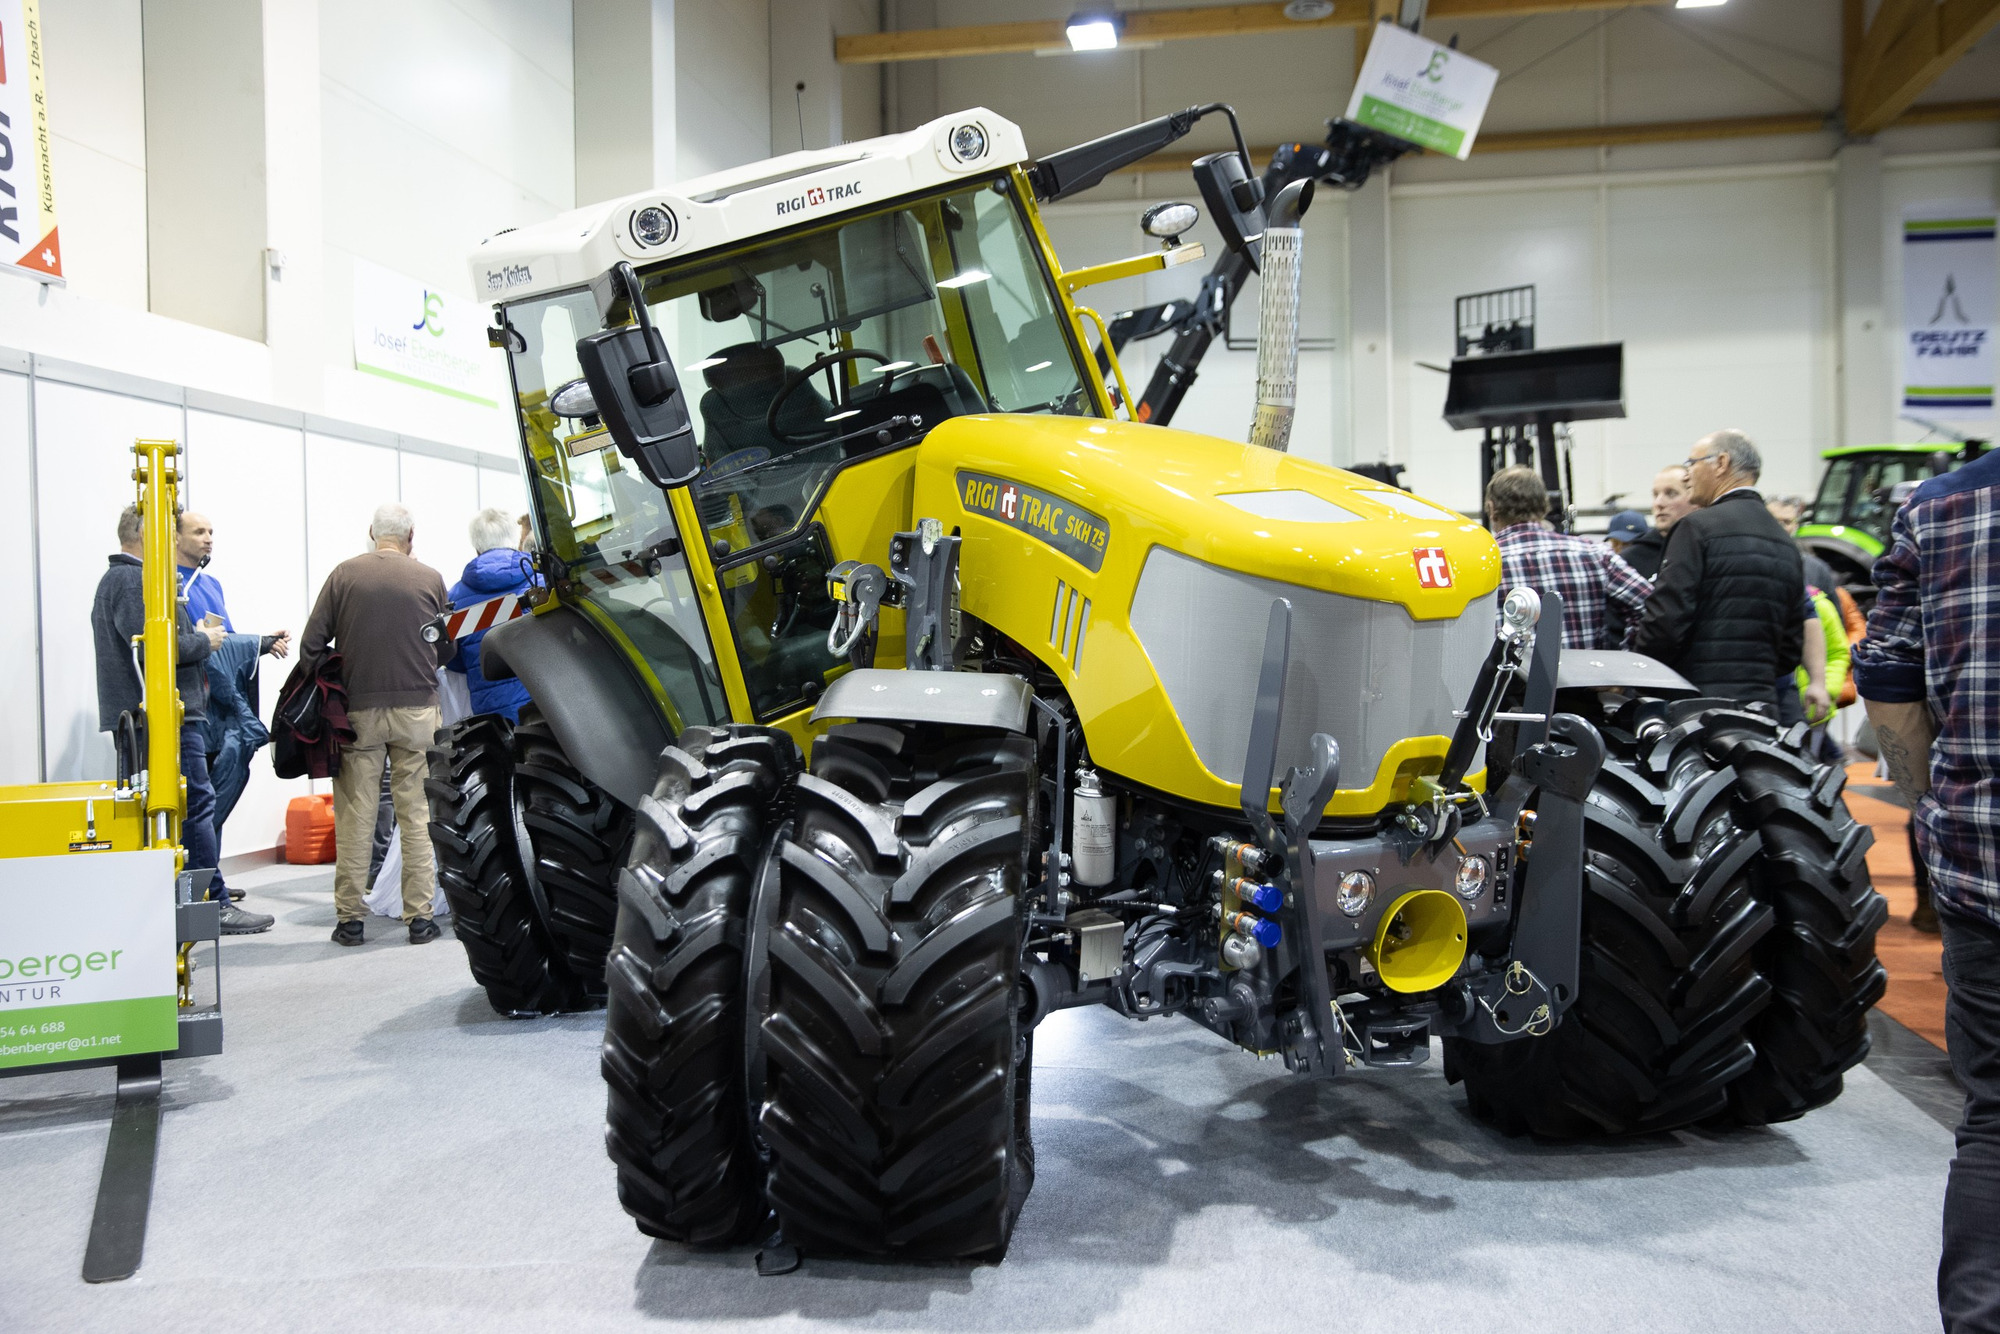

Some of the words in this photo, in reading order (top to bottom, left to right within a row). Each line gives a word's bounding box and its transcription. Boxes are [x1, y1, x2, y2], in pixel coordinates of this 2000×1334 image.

[28, 20, 41, 69] Ibach
[35, 91, 47, 121] a.R.
[38, 126, 53, 214] Küssnacht
[776, 196, 806, 216] RIGI
[826, 181, 862, 201] TRAC
[373, 326, 408, 353] Josef
[964, 479, 999, 511] RIGI
[1019, 493, 1064, 536] TRAC
[1064, 514, 1092, 544] SKH
[1091, 527, 1106, 547] 75
[0, 1026, 16, 1038] 54
[20, 1024, 37, 1036] 64
[41, 1021, 66, 1034] 688
